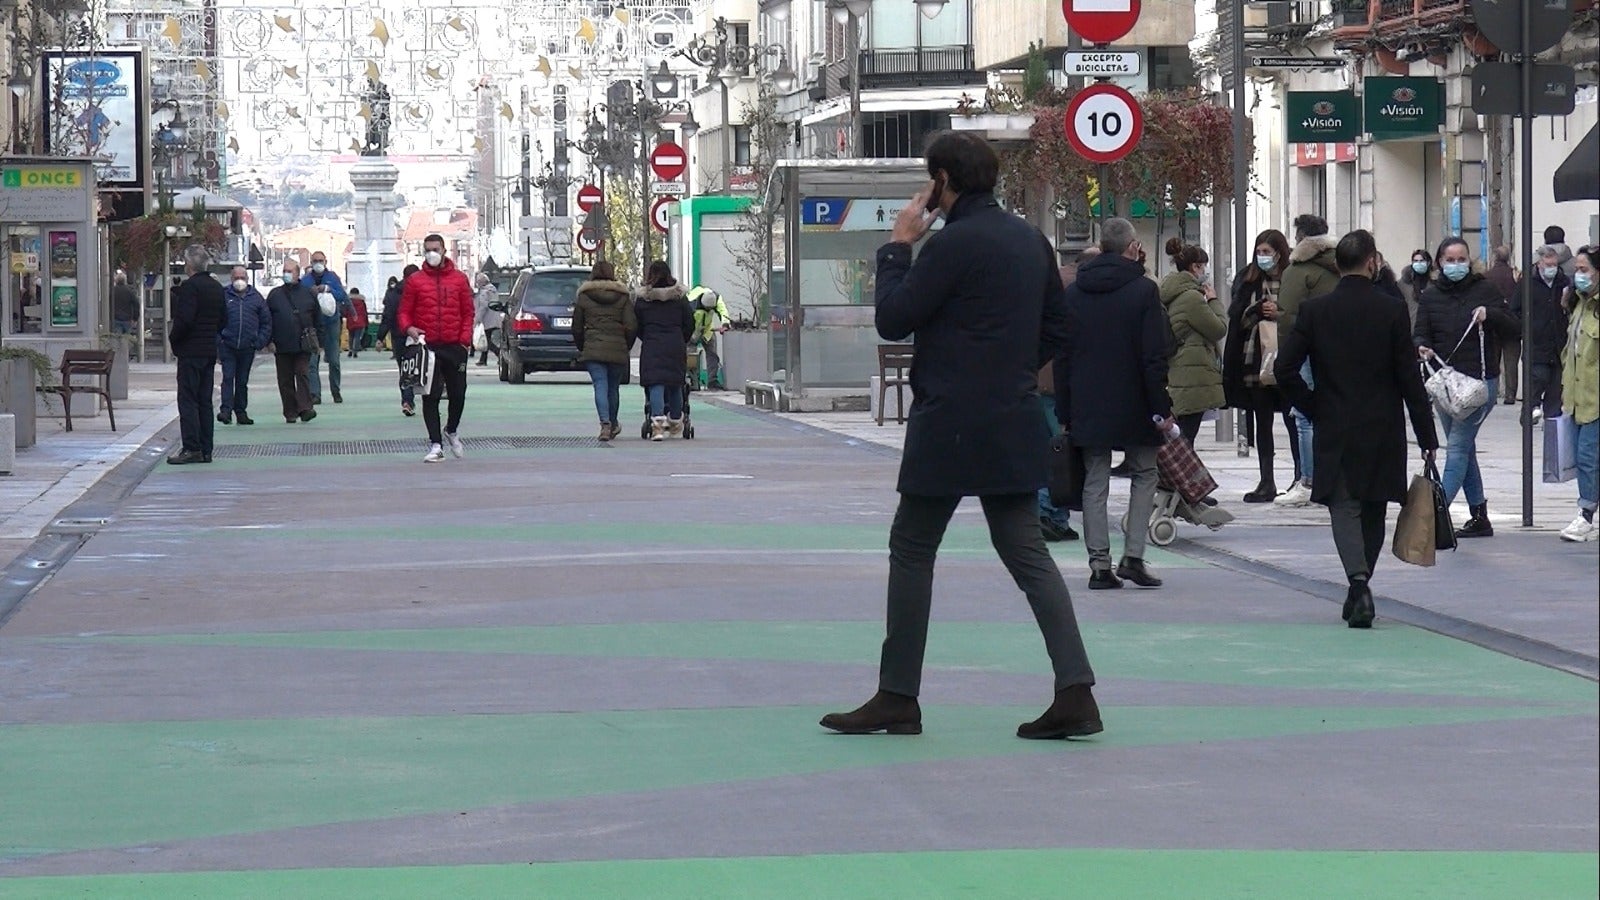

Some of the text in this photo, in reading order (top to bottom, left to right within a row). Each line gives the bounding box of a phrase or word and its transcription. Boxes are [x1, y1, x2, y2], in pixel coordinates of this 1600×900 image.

[1081, 54, 1123, 62] EXCEPTO
[1075, 64, 1129, 72] BICICLETAS
[1087, 112, 1122, 137] 10
[27, 172, 76, 184] ONCE
[815, 202, 831, 223] P
